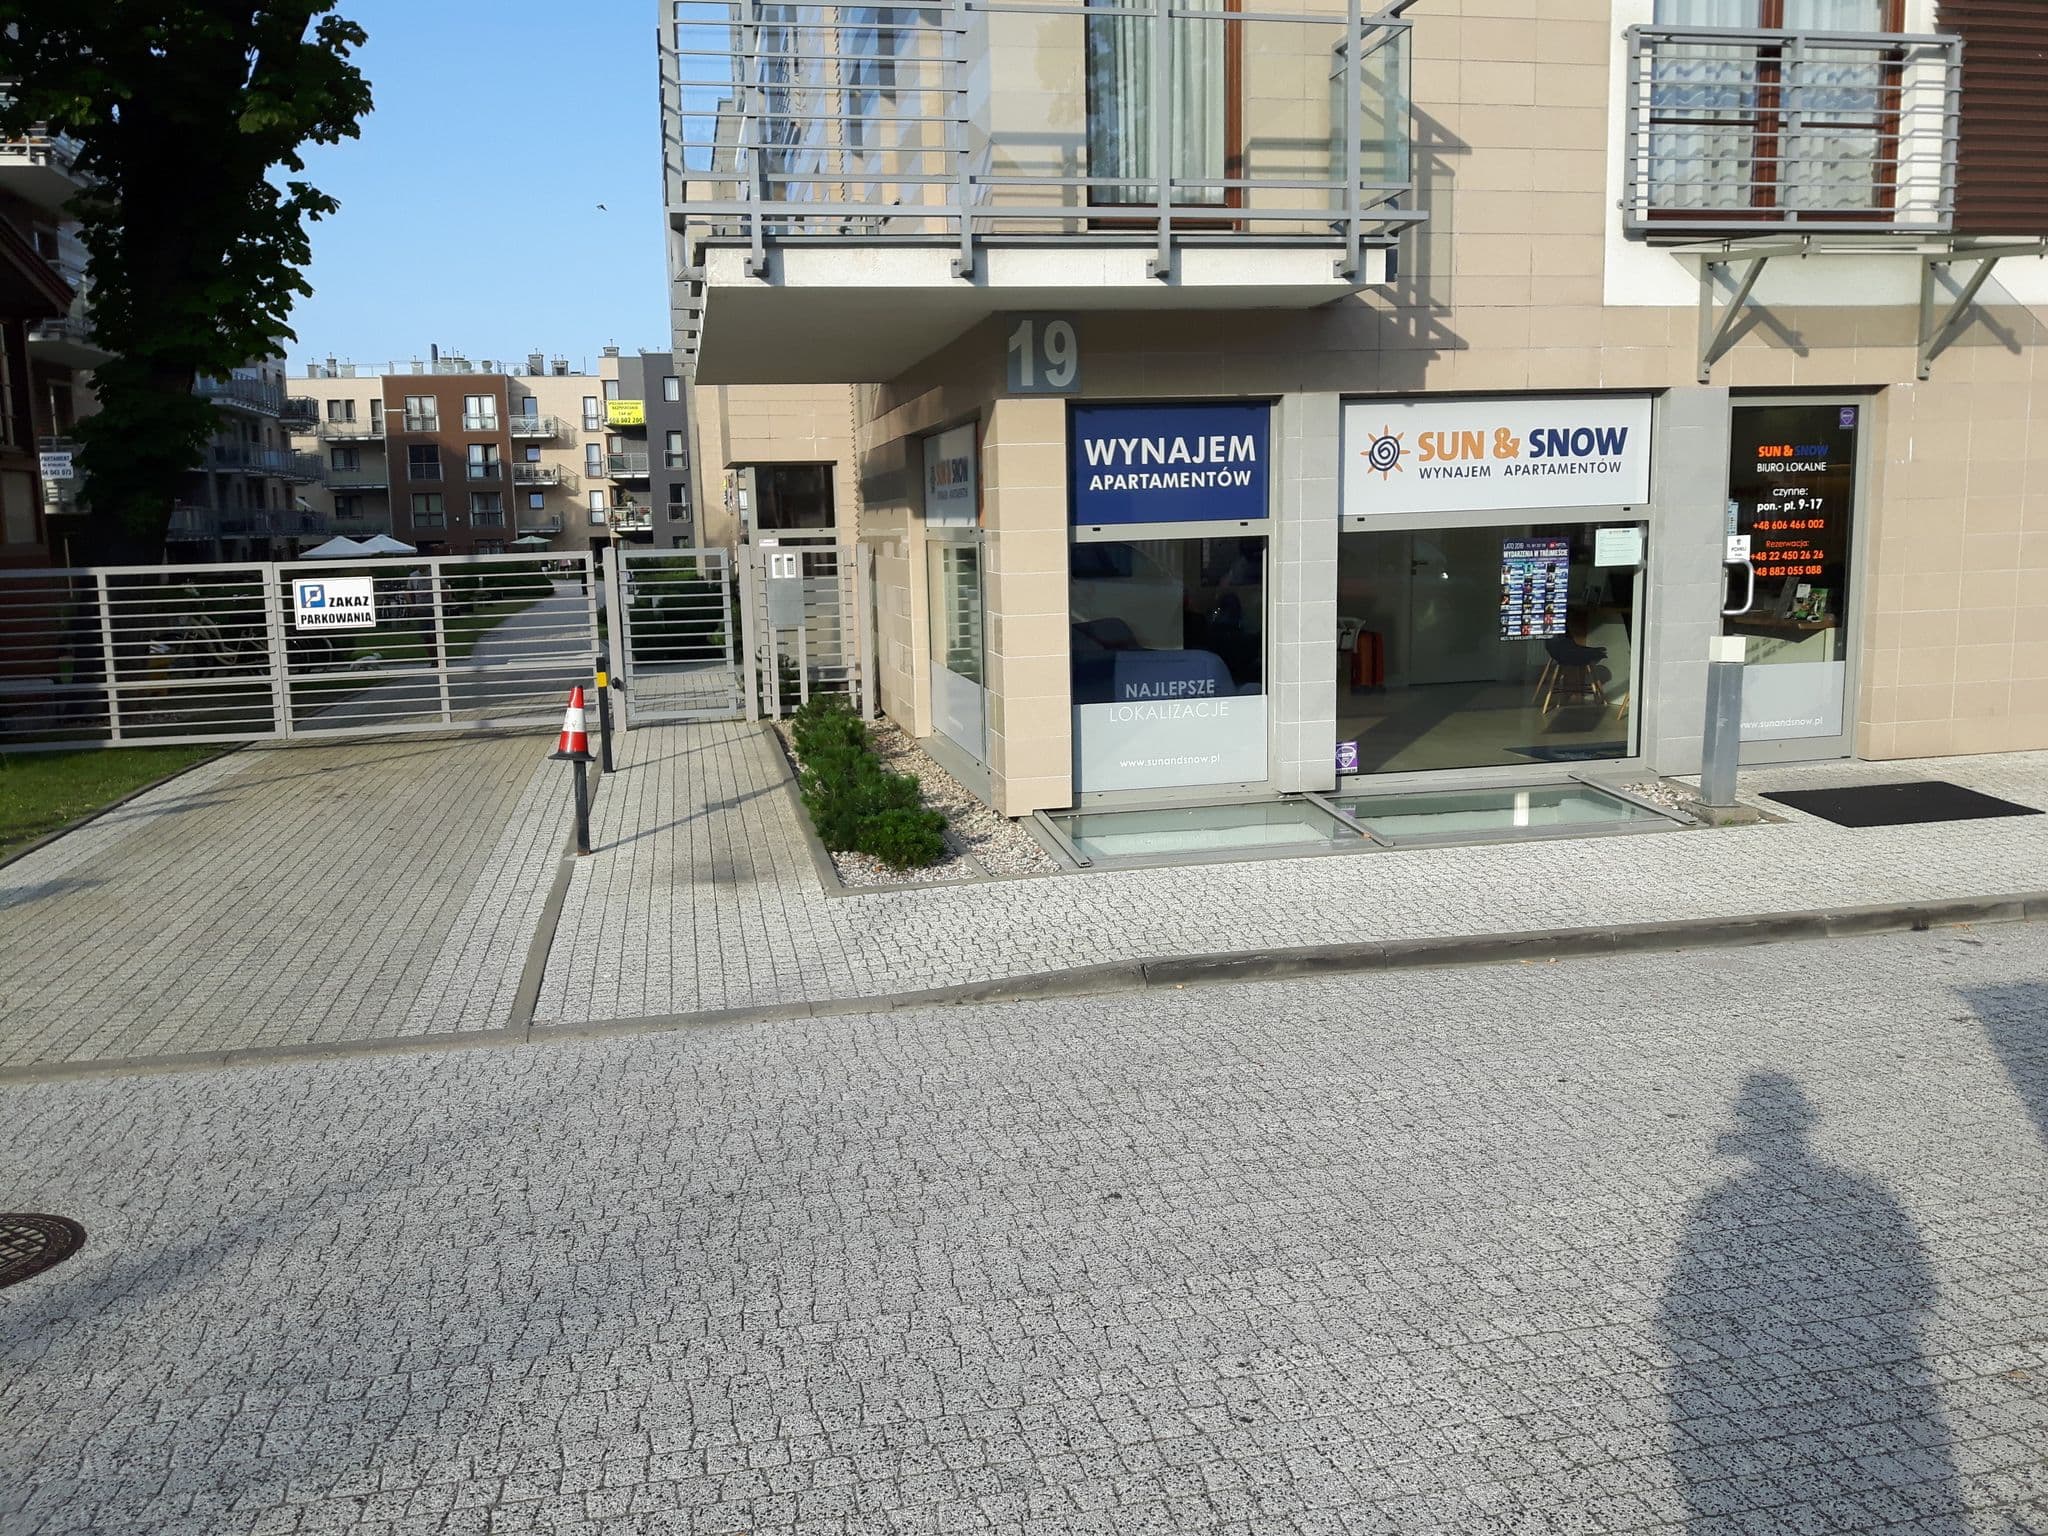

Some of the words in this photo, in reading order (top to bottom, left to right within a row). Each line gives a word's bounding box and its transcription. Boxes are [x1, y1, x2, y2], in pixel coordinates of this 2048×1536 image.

[1008, 319, 1078, 388] 19
[1084, 434, 1256, 466] WYNAJEM
[1417, 430, 1486, 462] SUN
[1492, 427, 1521, 460] &
[1528, 427, 1629, 459] SNOW
[1758, 445, 1781, 457] SUN
[1783, 445, 1794, 457] &
[1795, 444, 1829, 457] SNOW
[1418, 465, 1491, 479] WYNAJEM
[1503, 459, 1622, 477] APARTAMENTÓW
[1757, 463, 1785, 473] BIURO
[1786, 462, 1827, 472] LOKALNE
[1089, 467, 1252, 491] APARTAMENTÓW
[1772, 487, 1809, 498] czynne:
[1753, 520, 1770, 530] +48
[1771, 520, 1788, 529] 606
[1789, 520, 1806, 529] 466
[1807, 519, 1825, 529] 002
[1765, 540, 1810, 549] Rezerwacja:
[1751, 551, 1768, 561] +48
[1768, 551, 1781, 561] 22
[1781, 550, 1799, 560] 450
[1800, 550, 1812, 560] 26
[1813, 549, 1824, 559] 26
[1769, 566, 1786, 576] 882
[1787, 565, 1804, 575] 055
[1805, 564, 1822, 575] 088
[328, 595, 370, 608] ZAKAZ
[300, 611, 373, 625] PARKOWANIA
[1125, 679, 1215, 698] NAJLEPSZE
[1109, 701, 1230, 722] LOKALIZACJE
[1120, 753, 1220, 768] www.sunandsnow.pl
